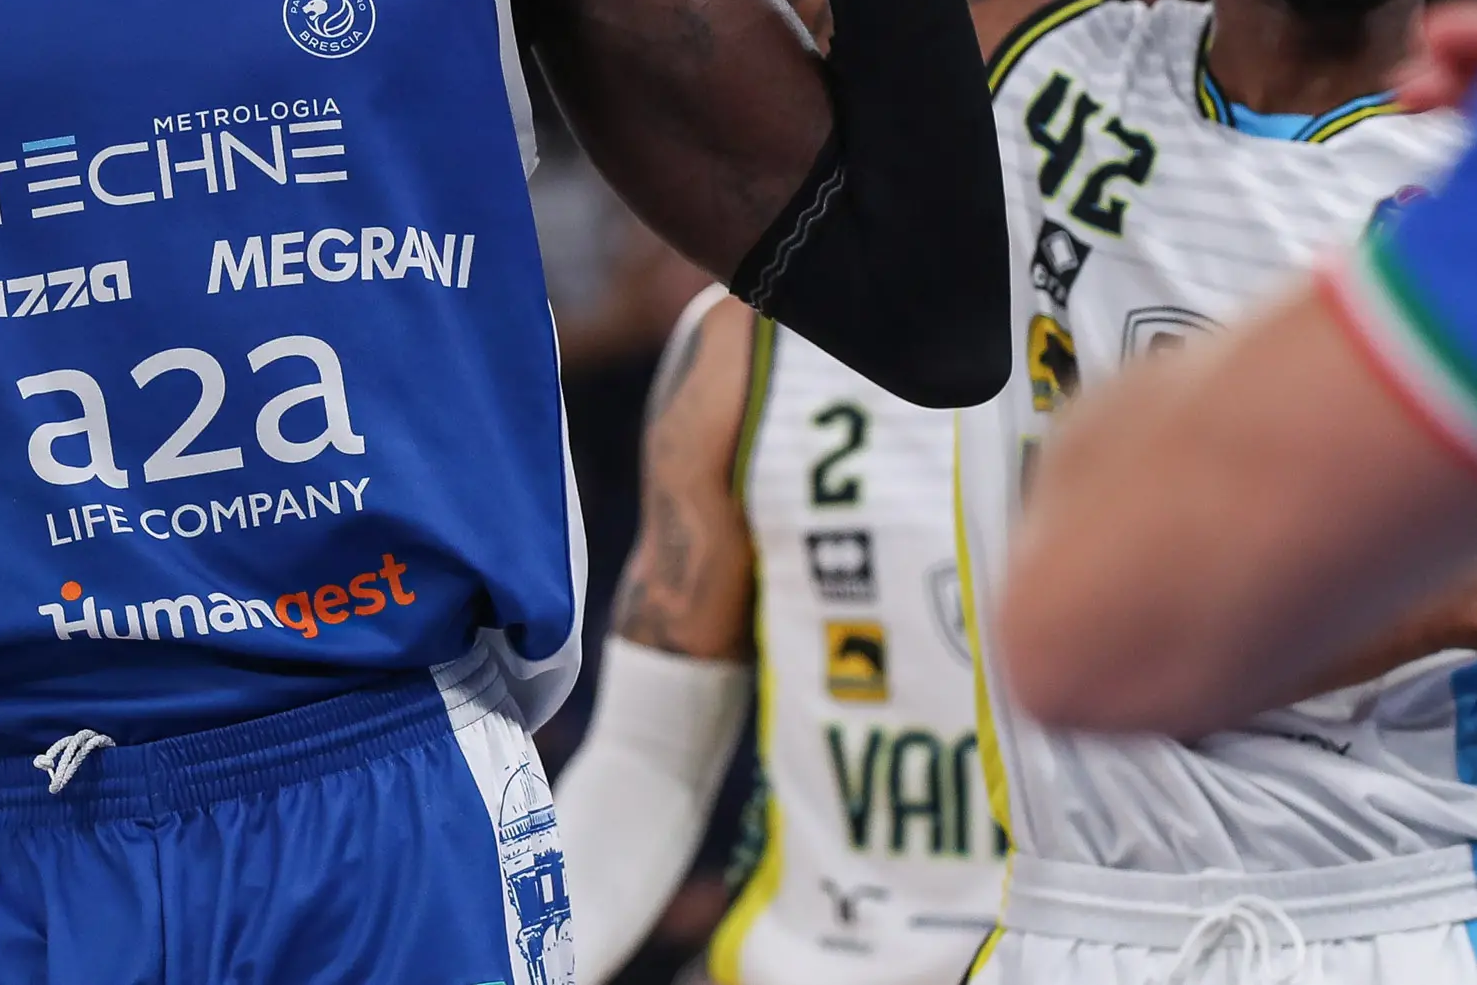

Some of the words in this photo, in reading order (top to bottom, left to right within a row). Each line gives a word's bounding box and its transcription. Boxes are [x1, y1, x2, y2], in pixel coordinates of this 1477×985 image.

[298, 29, 363, 52] BRESCIA
[153, 97, 342, 134] METROLOGIA
[1024, 71, 1157, 240] 42
[207, 226, 475, 294] MEGRANI
[16, 335, 365, 489] a2a
[811, 404, 870, 508] 2
[46, 504, 133, 546] LIFE
[140, 477, 370, 539] COMPANY
[38, 553, 416, 640] Humangest
